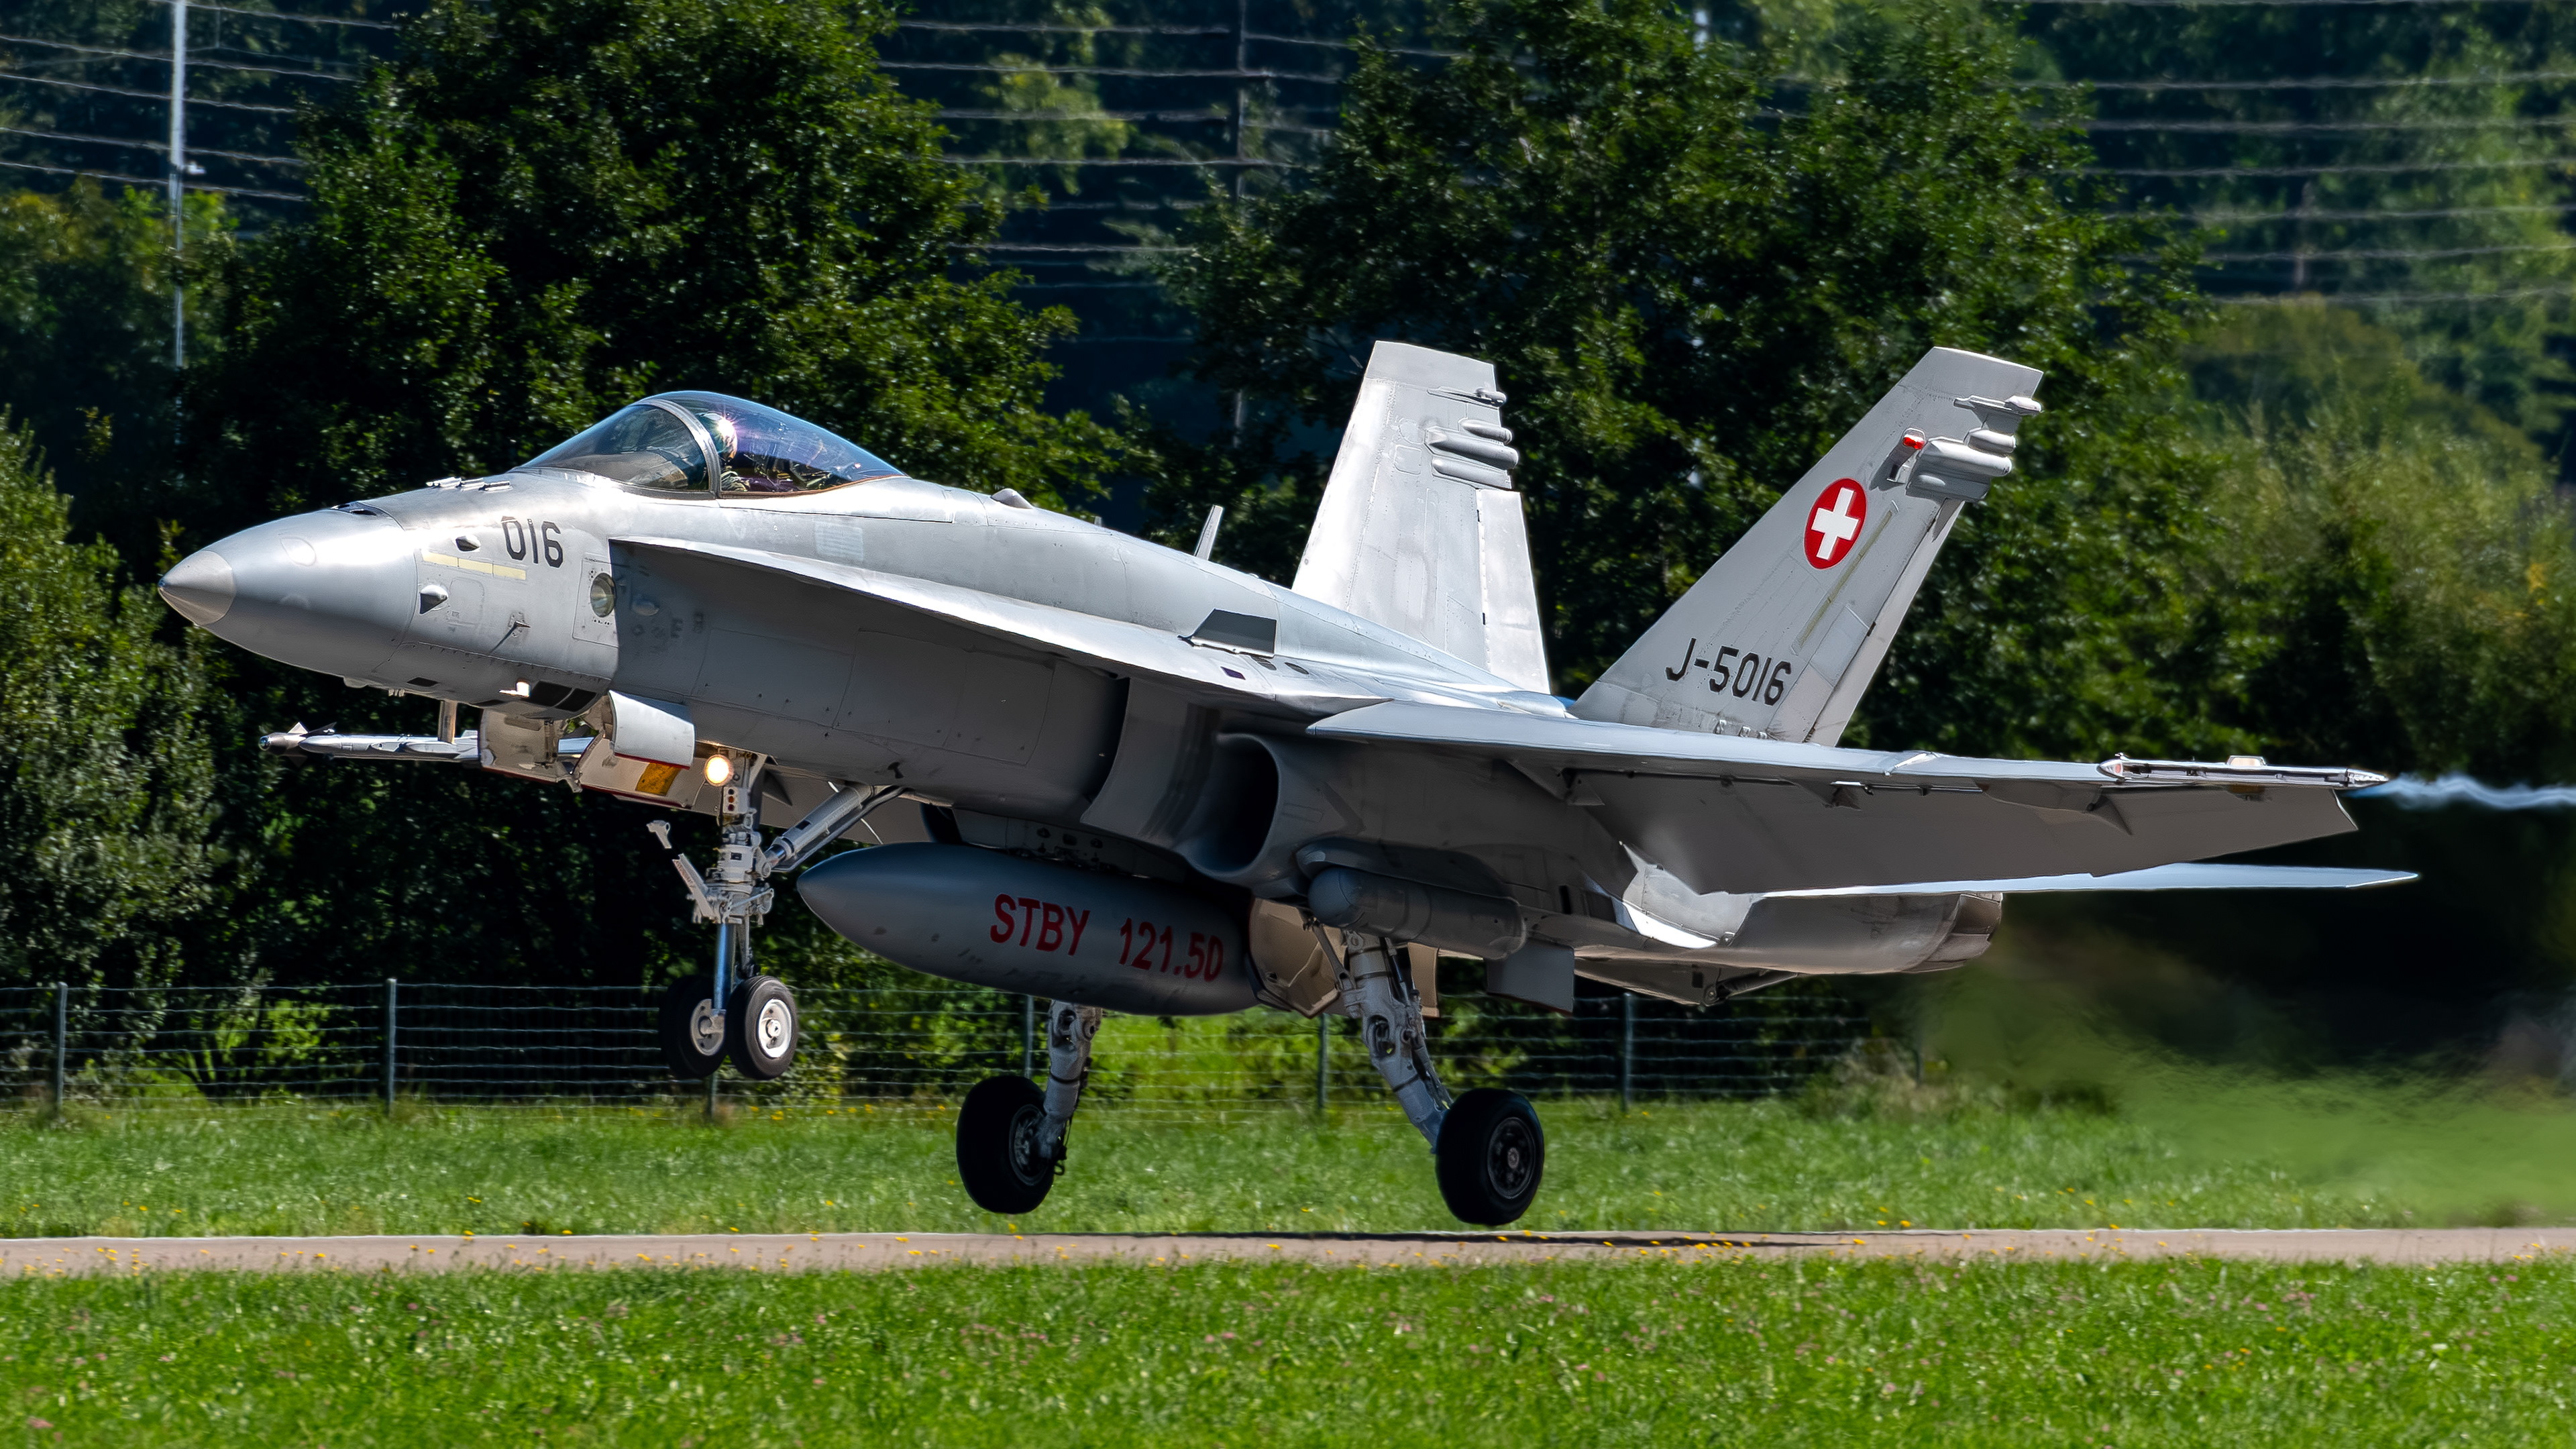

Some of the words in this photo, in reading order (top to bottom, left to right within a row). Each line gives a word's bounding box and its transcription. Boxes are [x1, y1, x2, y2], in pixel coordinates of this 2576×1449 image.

[502, 517, 563, 568] 016
[1666, 638, 1792, 706] J-5016
[990, 893, 1090, 956] STBY
[1120, 917, 1224, 981] 121.50
